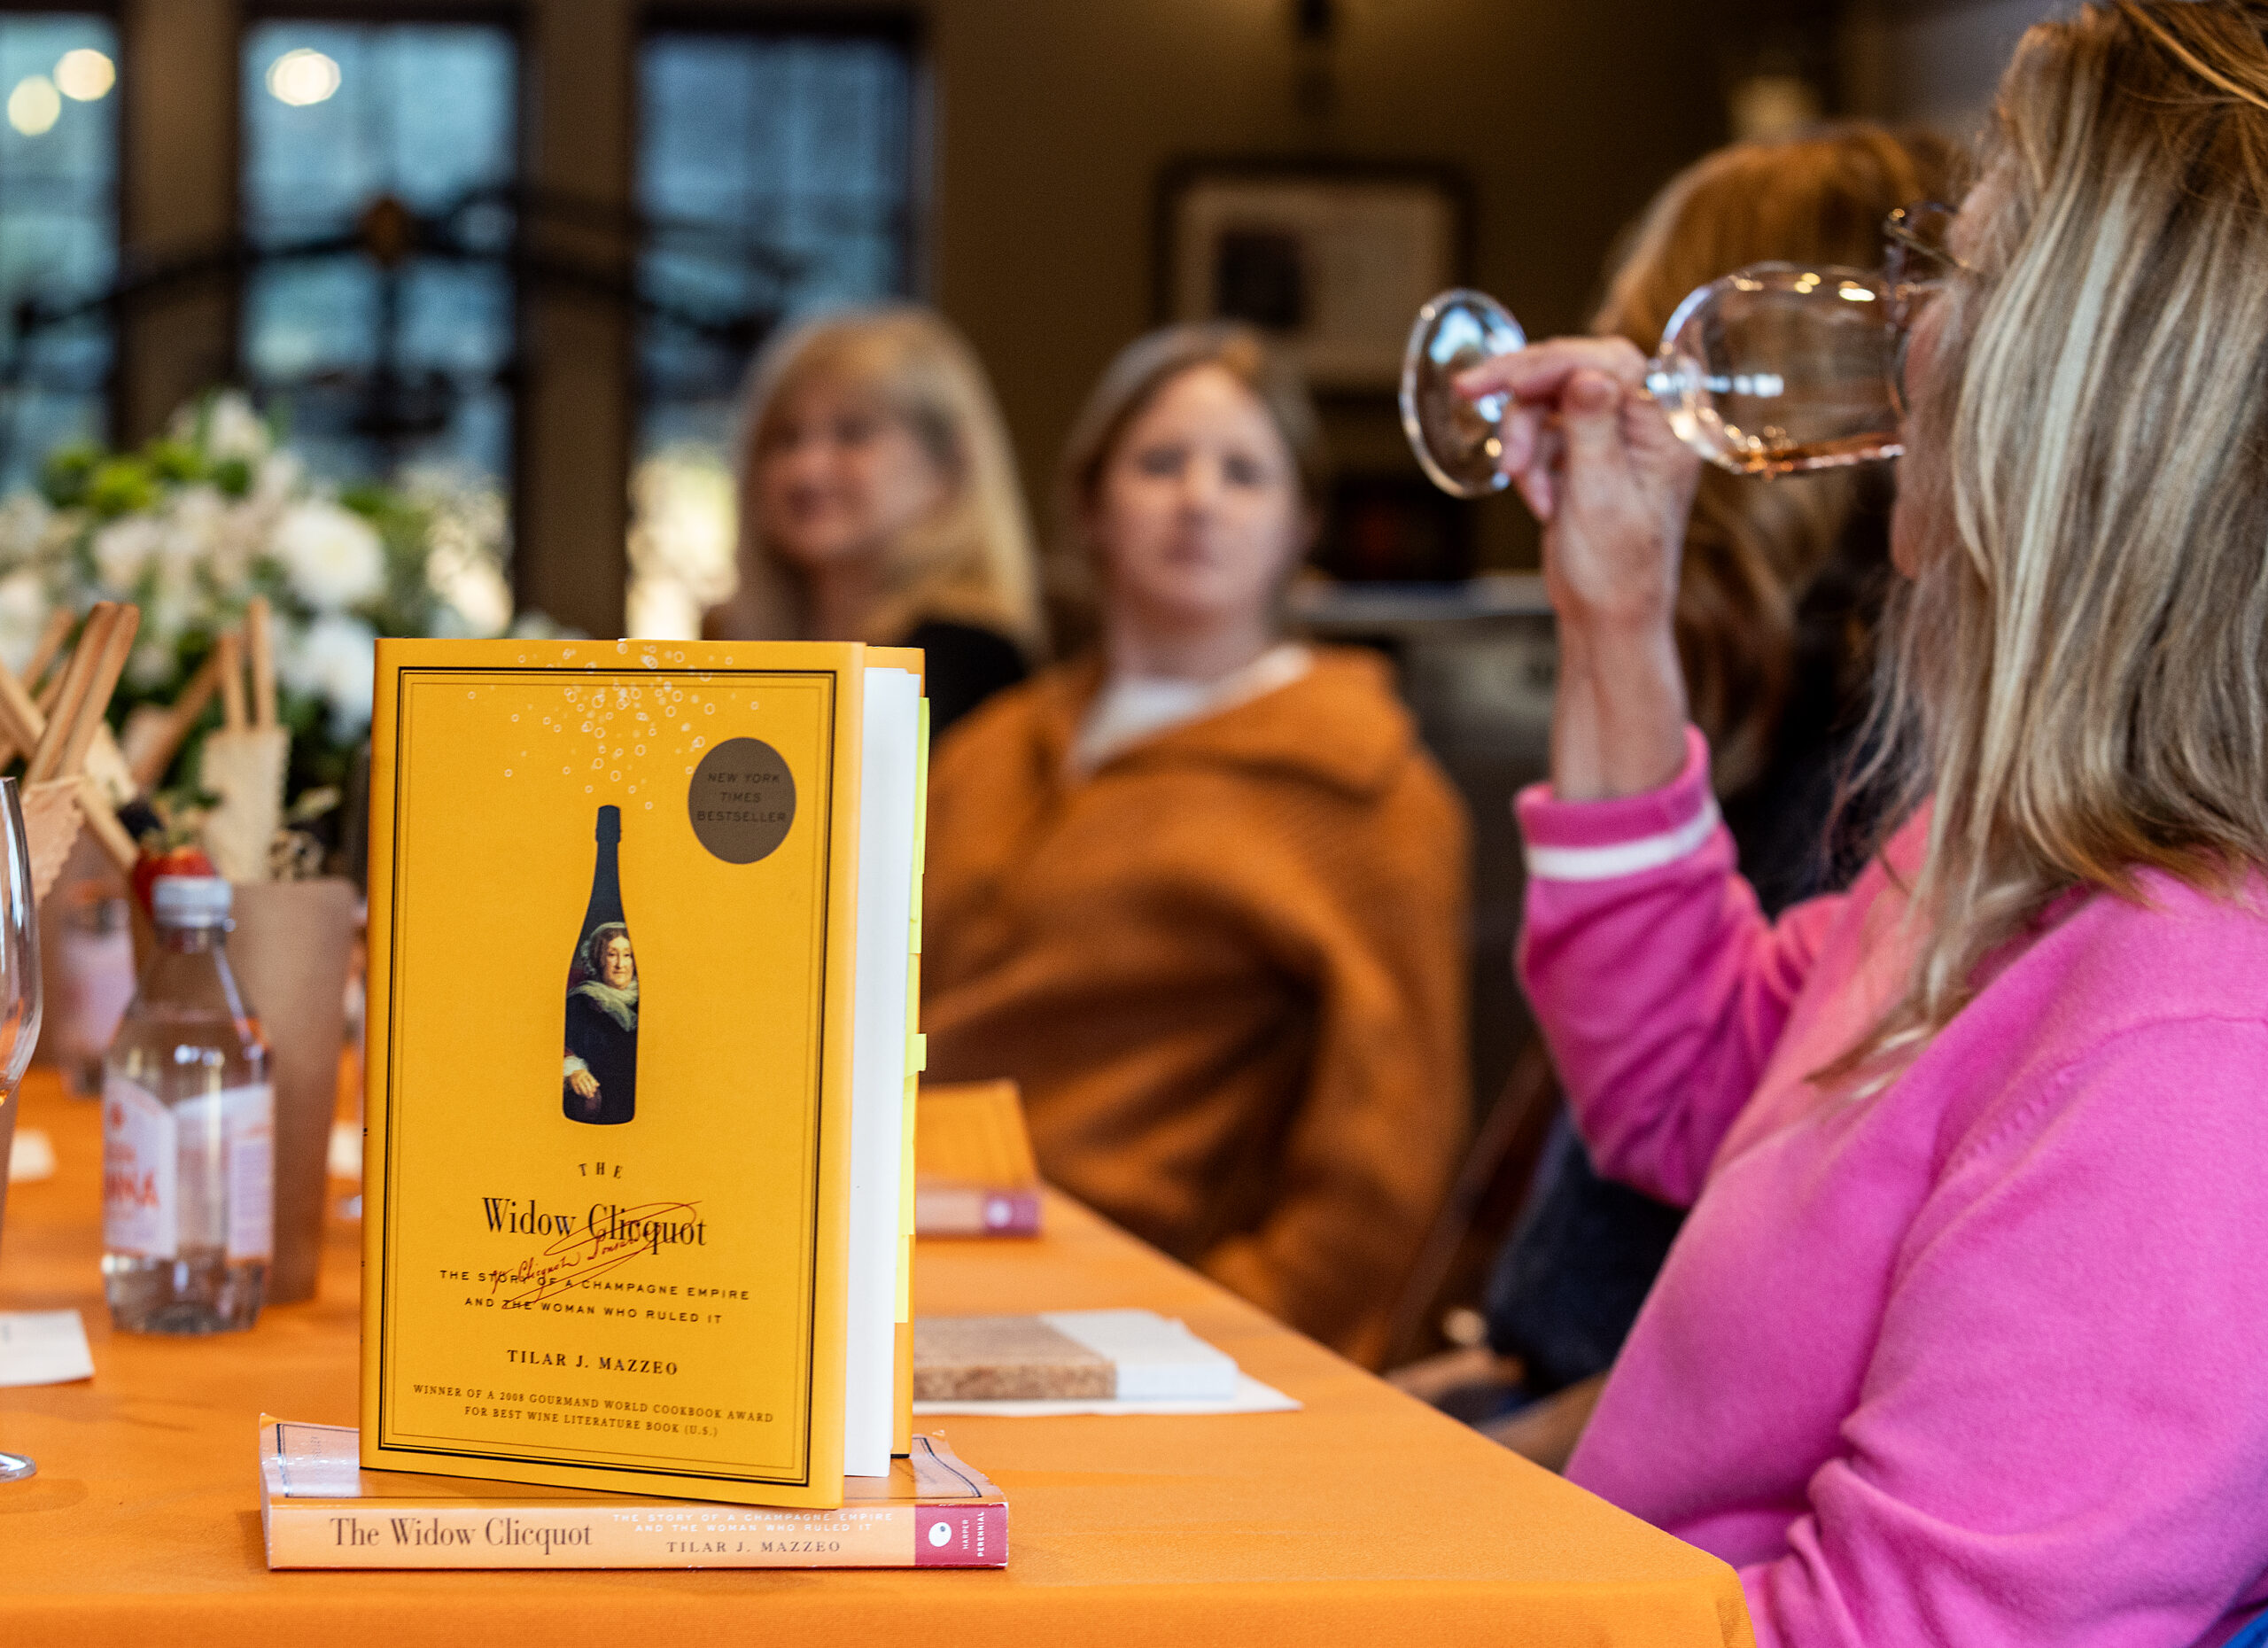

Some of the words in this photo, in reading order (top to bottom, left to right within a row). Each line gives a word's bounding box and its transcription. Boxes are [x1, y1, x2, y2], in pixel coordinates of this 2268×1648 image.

[708, 773, 737, 782] NEW
[743, 773, 780, 783] YORK
[720, 791, 762, 803] TIMES
[697, 810, 787, 822] BESTSELLER
[579, 1162, 624, 1179] THE
[483, 1197, 577, 1237] Widow
[588, 1203, 707, 1255] Clicquot
[440, 1270, 470, 1281] THE
[478, 1272, 528, 1285] STORY
[537, 1276, 557, 1287] OF
[565, 1279, 574, 1288] A
[581, 1279, 678, 1296] CHAMPAGNE
[687, 1287, 750, 1301] EMPIRE
[464, 1297, 495, 1308] AND
[502, 1299, 533, 1310] THE
[541, 1302, 595, 1315] WOMAN
[604, 1307, 637, 1318] WHO
[646, 1310, 700, 1323] RULED
[708, 1314, 722, 1324] IT
[507, 1349, 567, 1367] TILAR
[576, 1355, 589, 1368] J.
[599, 1356, 678, 1375] MAZZEO
[413, 1384, 462, 1397] WINNER
[466, 1388, 483, 1399] OF
[487, 1391, 494, 1400] A
[500, 1392, 524, 1403] 2008
[530, 1394, 599, 1409] GOURMAND
[604, 1400, 649, 1412] WORLD
[653, 1404, 723, 1419] COOKBOOK
[726, 1411, 774, 1423] AWARD
[465, 1406, 488, 1418] FOR
[493, 1409, 523, 1420] BEST
[527, 1411, 559, 1423] WINE
[563, 1414, 641, 1430] LITERATURE
[646, 1421, 680, 1433] BOOK
[684, 1425, 718, 1438] (U.S.)
[707, 1523, 757, 1532] WOMAN
[765, 1523, 796, 1532] WHO
[804, 1522, 850, 1532] RULED
[858, 1522, 873, 1532] IT
[744, 1513, 831, 1522] CHAMPAGNE
[839, 1512, 893, 1522] EMPIRE
[329, 1518, 380, 1547] The
[390, 1518, 478, 1547] Widow
[485, 1517, 594, 1556] Clicquot
[666, 1542, 726, 1552] TILAR
[736, 1542, 751, 1553] J.
[761, 1541, 841, 1552] MAZZEO
[961, 1519, 970, 1551] HARPER
[976, 1511, 986, 1558] PERENNIAL
